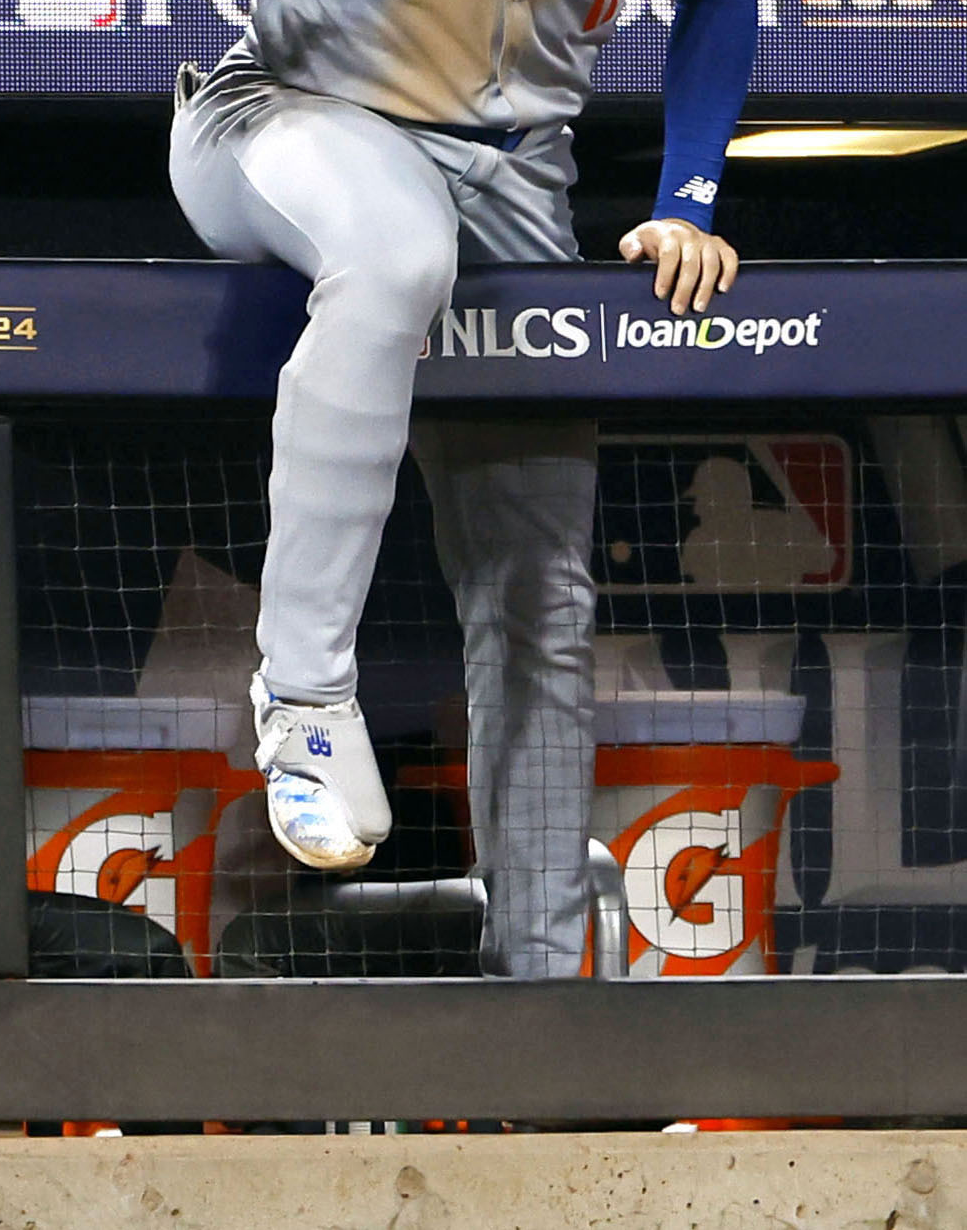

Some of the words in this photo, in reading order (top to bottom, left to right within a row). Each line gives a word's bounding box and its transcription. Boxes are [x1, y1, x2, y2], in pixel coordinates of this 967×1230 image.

[441, 307, 591, 358] NLCS
[616, 312, 823, 355] loanDepot
[624, 809, 745, 960] G
